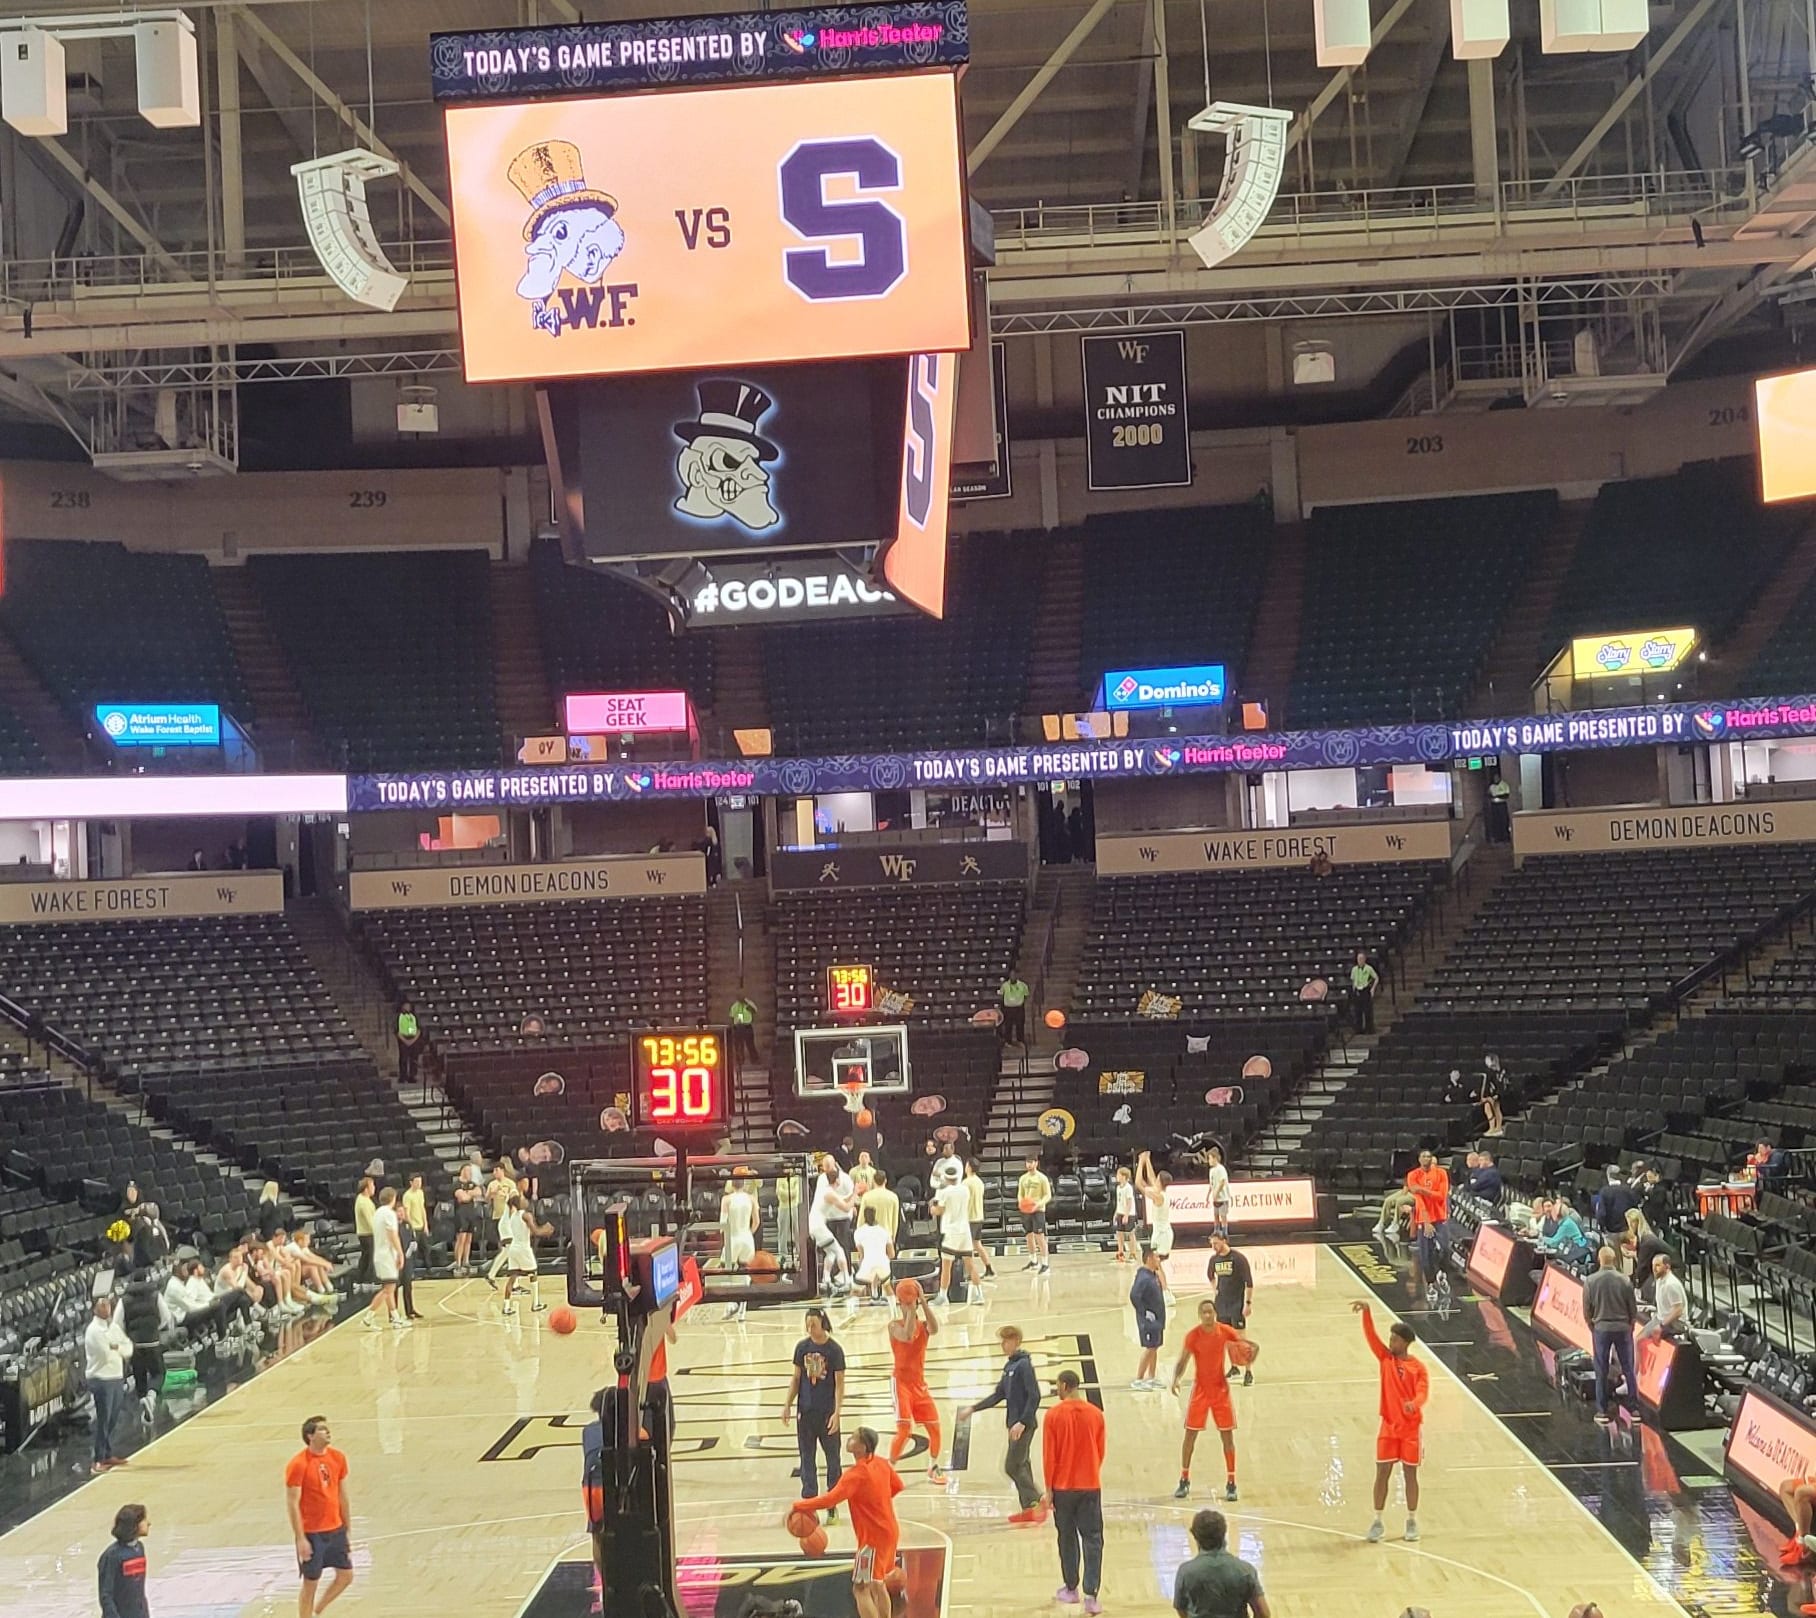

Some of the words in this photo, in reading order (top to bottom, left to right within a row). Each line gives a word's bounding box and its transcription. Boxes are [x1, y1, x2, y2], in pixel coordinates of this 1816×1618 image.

[464, 47, 550, 76] TODAY'S
[558, 42, 612, 69] GAME
[620, 32, 732, 66] PRESENTED
[741, 31, 767, 57] BY
[675, 207, 731, 250] VS
[777, 134, 909, 303] S
[557, 283, 638, 330] W.F.
[1117, 340, 1149, 363] WF
[1105, 383, 1166, 405] NIT
[1097, 403, 1176, 419] CHAMPIONS
[1112, 423, 1163, 447] 2000
[1407, 435, 1443, 454] 203
[50, 491, 90, 509] 238
[349, 490, 387, 508] 239
[1596, 641, 1632, 664] Starry
[1640, 638, 1676, 660] Starry
[1139, 680, 1221, 701] Domino's
[607, 698, 645, 712] SEAT
[130, 713, 168, 724] Atrium
[168, 713, 202, 724] Health
[606, 712, 647, 726] GEEK
[130, 725, 155, 734] Wake
[156, 725, 183, 734] Forest
[183, 725, 213, 735] Baptist
[1453, 726, 1517, 750] TODAY'S
[1522, 722, 1563, 745] GAME
[1569, 715, 1657, 742] PRESENTED
[1663, 713, 1684, 734] BY
[914, 757, 980, 780] TODAY'S
[986, 754, 1028, 776] GAME
[1034, 750, 1120, 773] PRESENTED
[1124, 749, 1144, 769] BY
[378, 781, 446, 803] TODAY'S
[452, 778, 495, 799] GAME
[501, 775, 588, 797] PRESENTED
[593, 774, 614, 794] BY
[1554, 825, 1574, 841] WF
[1610, 817, 1677, 841] DEMON
[1682, 812, 1775, 838] DEACONS
[1204, 840, 1258, 862] WAKE
[1264, 836, 1337, 859] FOREST
[1386, 835, 1407, 850] WF
[1139, 847, 1160, 862] WF
[646, 869, 667, 885] WF
[879, 855, 916, 881] WF
[392, 881, 413, 896] WF
[450, 874, 516, 896] DEMON
[521, 870, 609, 893] DEACONS
[31, 891, 88, 913] WAKE
[94, 888, 170, 910] FOREST
[216, 887, 237, 903] WF
[837, 983, 864, 1008] 30
[652, 1068, 711, 1117] 30
